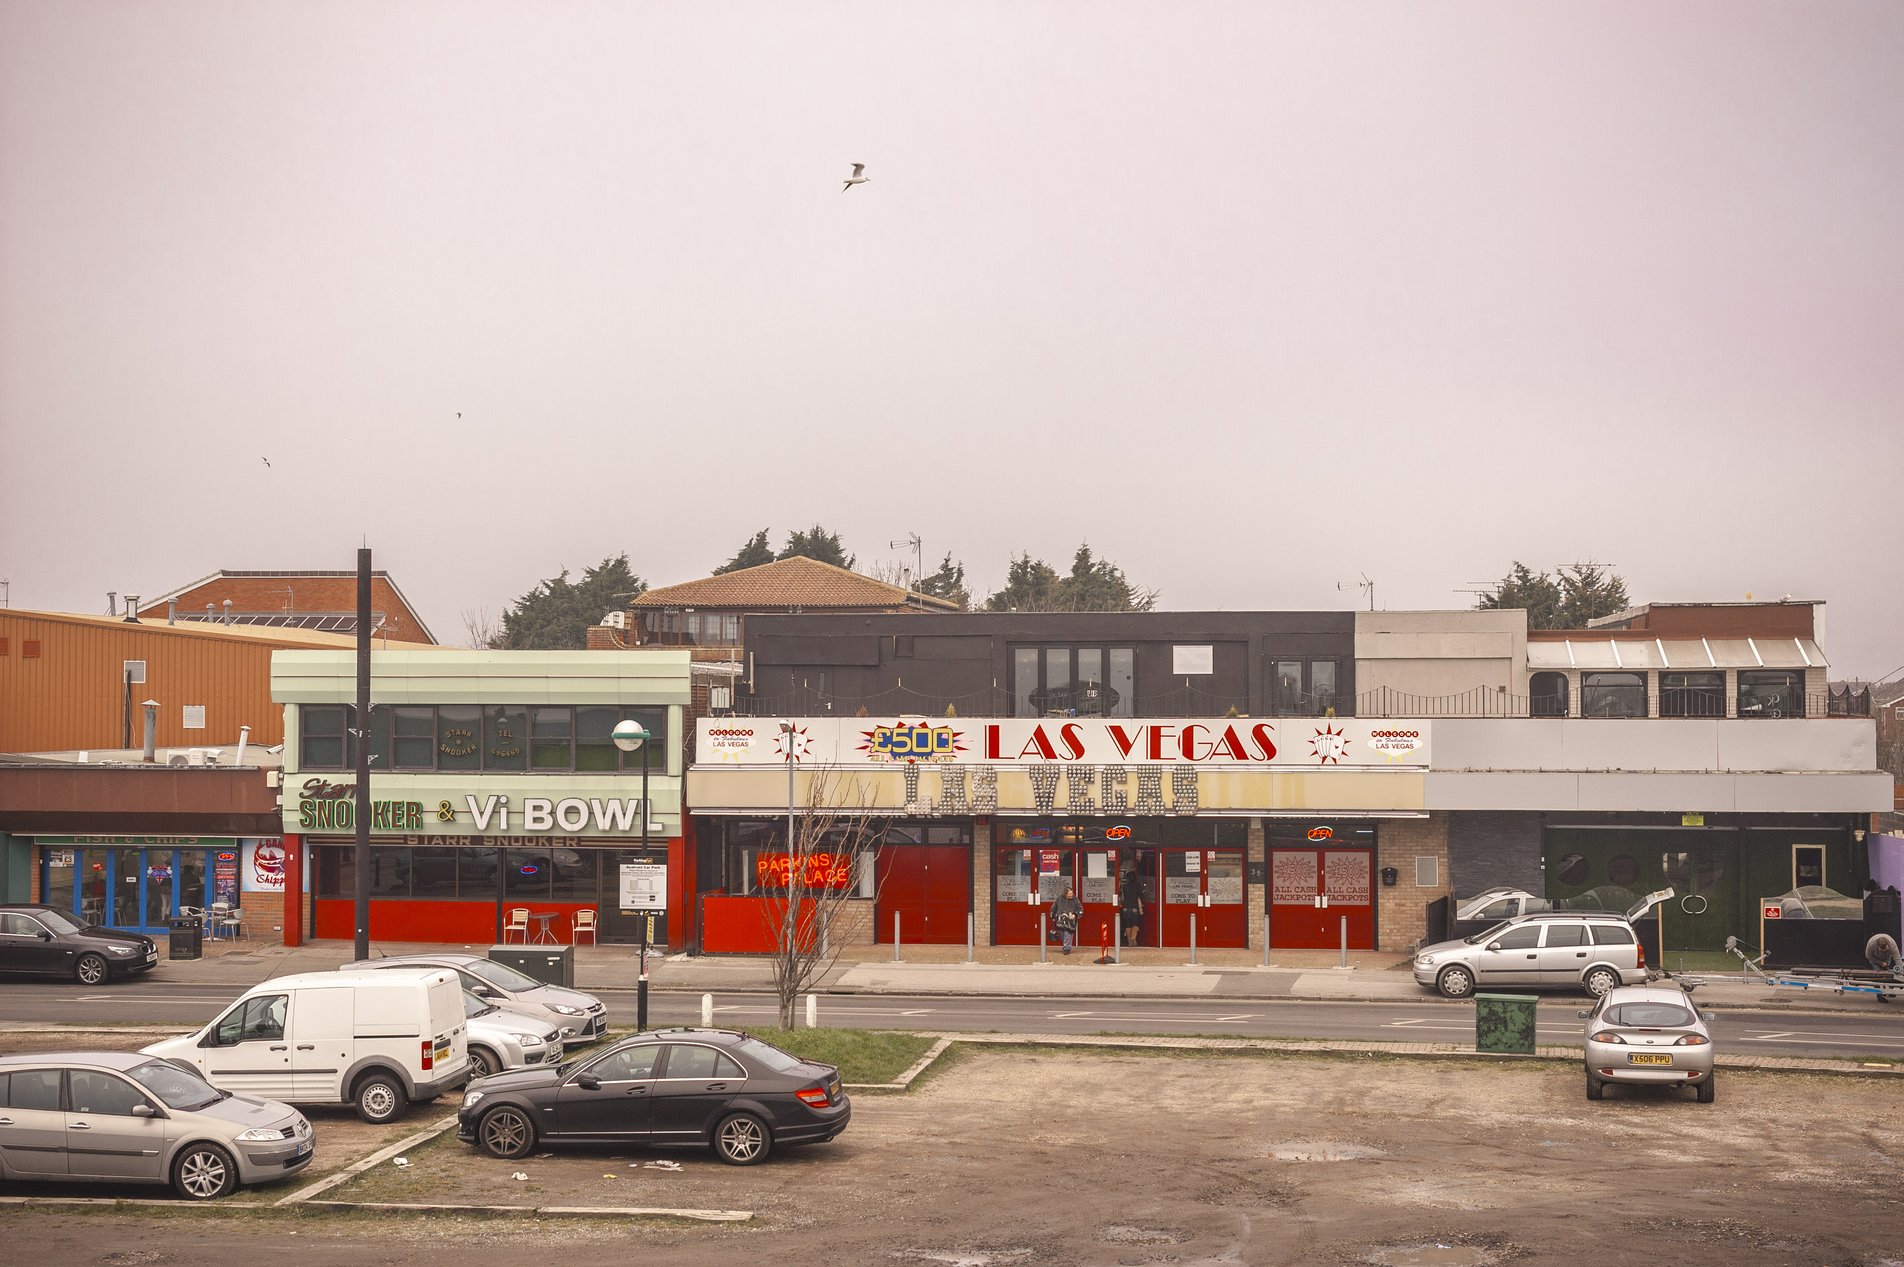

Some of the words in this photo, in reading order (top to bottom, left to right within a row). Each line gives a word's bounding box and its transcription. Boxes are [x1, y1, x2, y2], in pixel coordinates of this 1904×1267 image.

[445, 729, 472, 738] STARR
[870, 728, 954, 753] £500
[984, 723, 1086, 760] LAS
[1104, 723, 1277, 761] VEGAS
[440, 743, 478, 756] SNOOKER
[904, 764, 998, 815] LAS
[1029, 764, 1198, 816] VEGAS
[299, 799, 424, 830] SNOKER
[437, 800, 456, 822] &
[465, 794, 509, 831] Vi
[524, 797, 663, 832] BOWL
[1105, 827, 1132, 838] OPEN
[1307, 829, 1333, 838] OPEN
[407, 835, 472, 845] STARR
[483, 836, 578, 847] SNOOKER
[1634, 1055, 1654, 1063] X506
[1655, 1055, 1670, 1063] PPU
